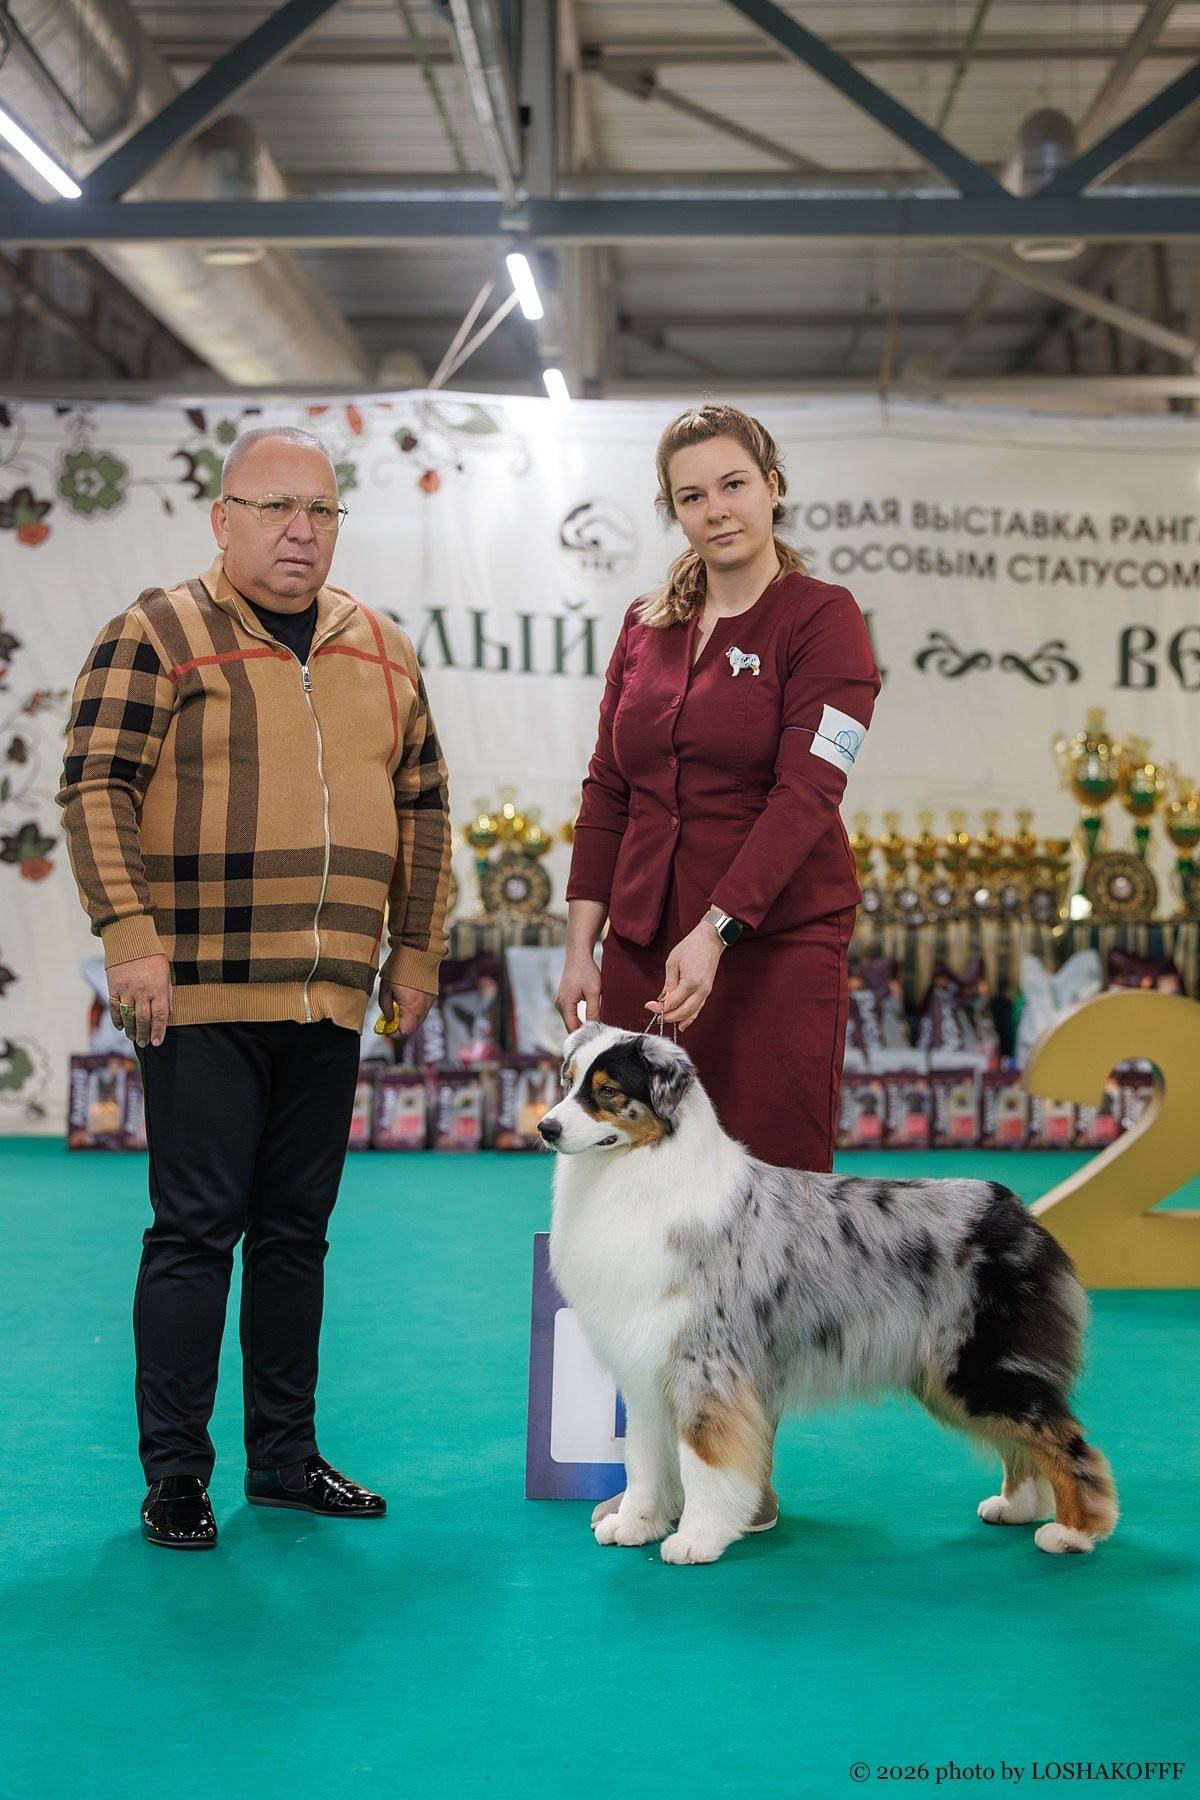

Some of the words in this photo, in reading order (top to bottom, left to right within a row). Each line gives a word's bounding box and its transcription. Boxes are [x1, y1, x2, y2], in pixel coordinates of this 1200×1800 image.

[912, 501, 1098, 541] ВЫСТАВКА
[1110, 514, 1200, 547] РАНГ
[829, 543, 996, 580] ОСОБЫМ
[1007, 553, 1200, 590] СТАТУСОМ
[386, 599, 602, 678] ЛЫЙ
[1024, 989, 1200, 1289] 2
